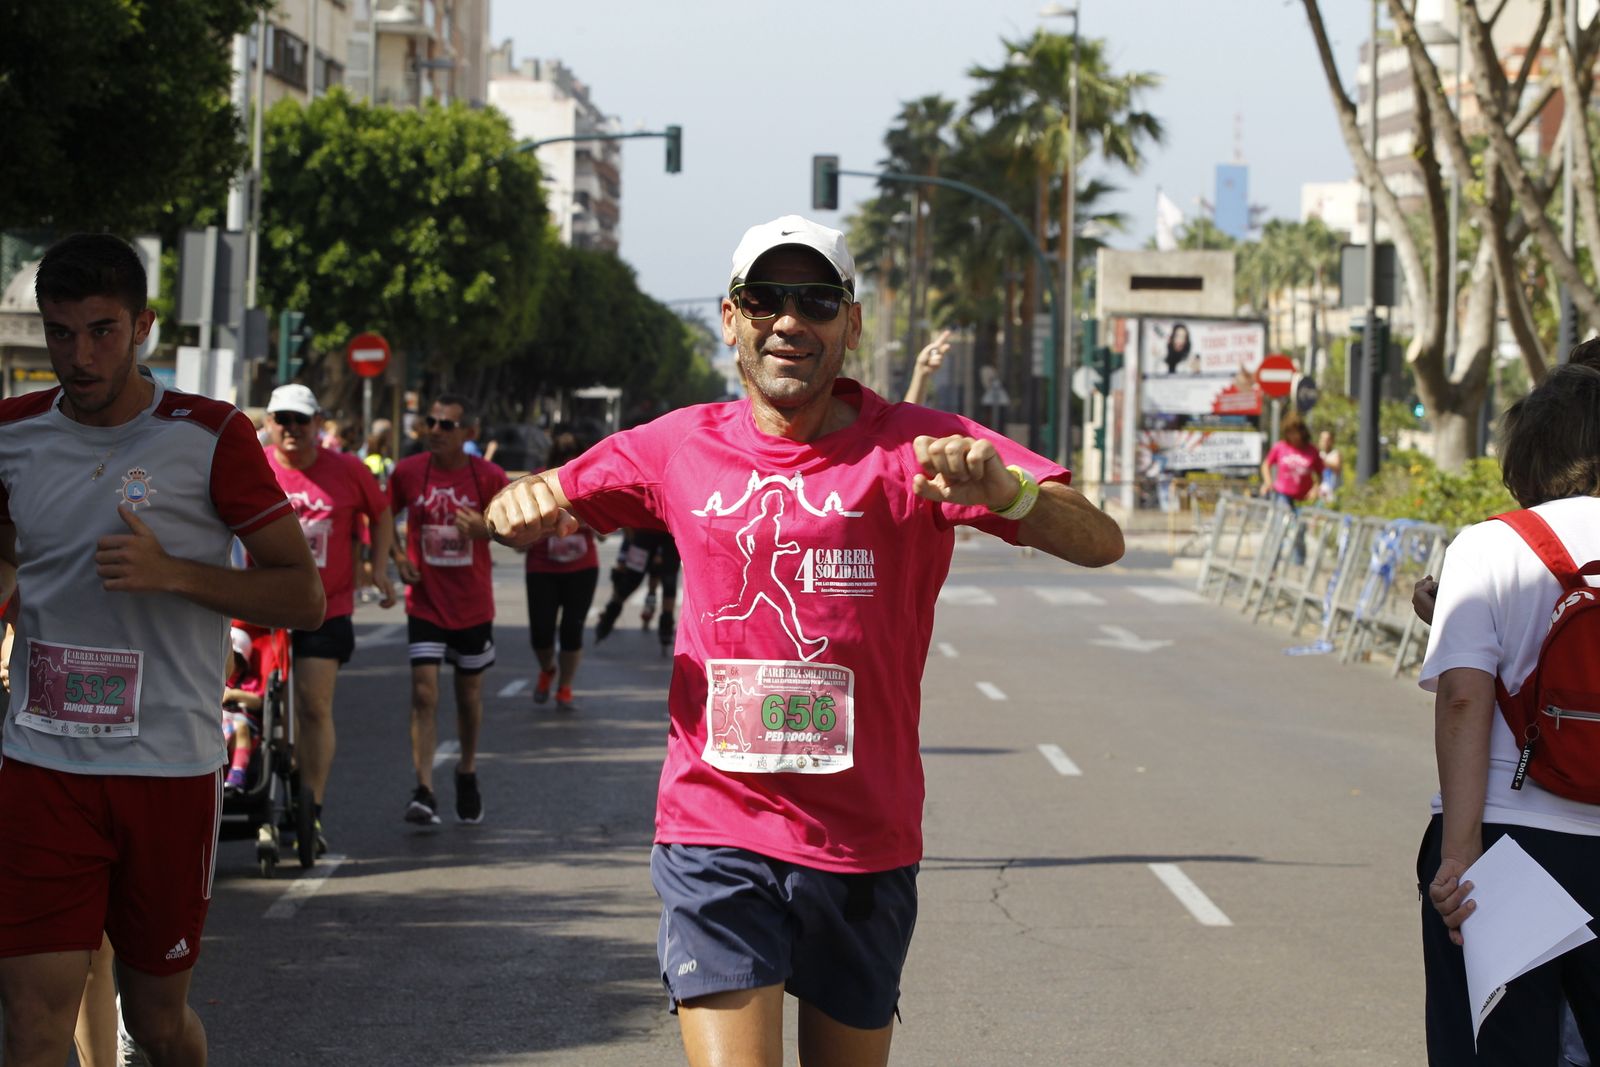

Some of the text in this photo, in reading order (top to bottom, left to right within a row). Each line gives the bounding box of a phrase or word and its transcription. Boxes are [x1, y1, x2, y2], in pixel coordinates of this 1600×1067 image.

[794, 548, 875, 593] 4 CARRERA
[815, 564, 875, 579] SOLIDARIA
[67, 650, 99, 662] CARRERA
[100, 652, 137, 665] SOLIDARIA
[754, 665, 847, 686] 4 CARRERA SOLIDARIA
[64, 671, 127, 706] 532
[95, 704, 118, 715] TEAM
[761, 694, 837, 732] 656
[165, 948, 190, 960] adidas
